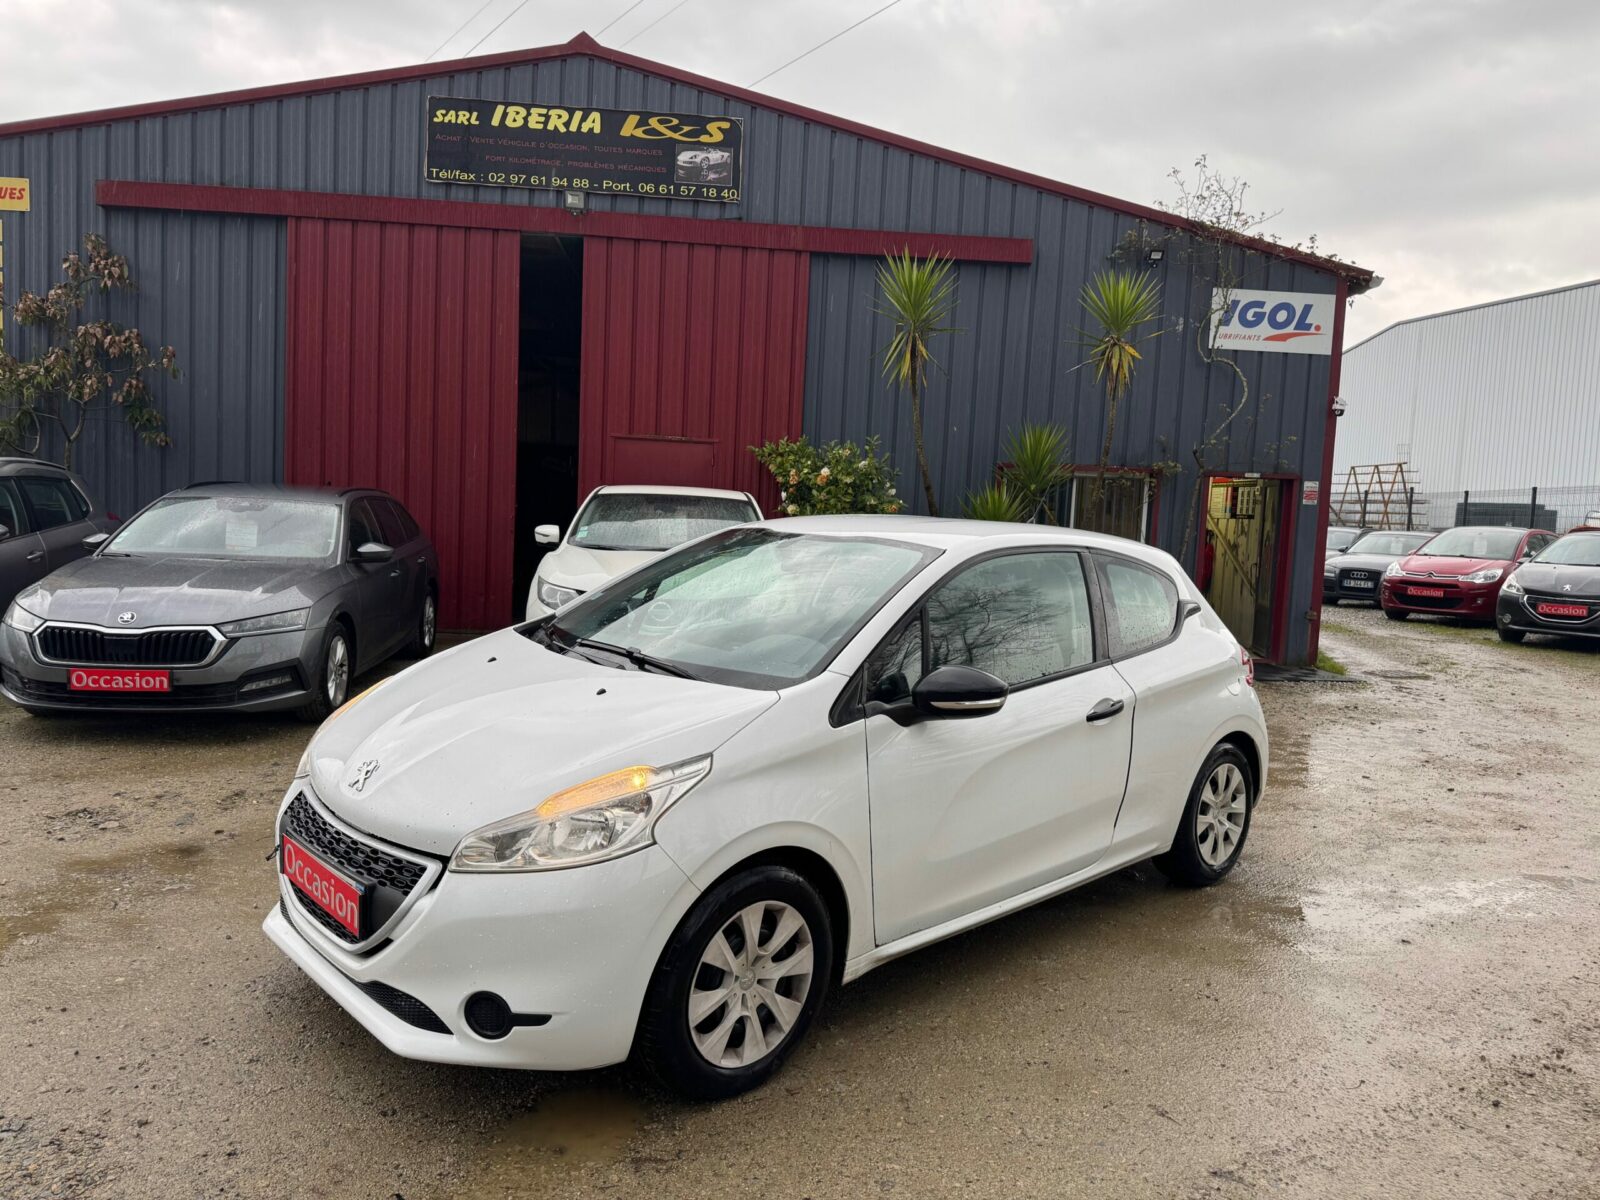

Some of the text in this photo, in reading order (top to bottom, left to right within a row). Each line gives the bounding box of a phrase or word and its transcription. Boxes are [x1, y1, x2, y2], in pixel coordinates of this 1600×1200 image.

[433, 109, 480, 126] SARL
[490, 104, 601, 134] IBERIA
[435, 133, 462, 142] ACHAT
[470, 136, 495, 145] VENTE
[594, 145, 623, 154] TOUTES
[626, 147, 663, 156] MARQUES
[429, 168, 476, 181] Tél/fax
[488, 172, 505, 183] 02
[509, 174, 527, 184] 97
[530, 175, 546, 185] 61
[551, 177, 568, 187] 94
[572, 178, 590, 189] 88
[603, 180, 634, 192] Port.
[638, 183, 655, 193] 06
[659, 184, 675, 195] 61
[680, 186, 697, 196] 57
[701, 187, 717, 198] 18
[720, 189, 738, 199] 40
[1218, 333, 1261, 341] UBRIFIANTS
[1407, 587, 1444, 598] Occasion
[1538, 604, 1587, 616] Occasion
[71, 671, 168, 689] Occasion
[284, 843, 359, 929] Occasion
